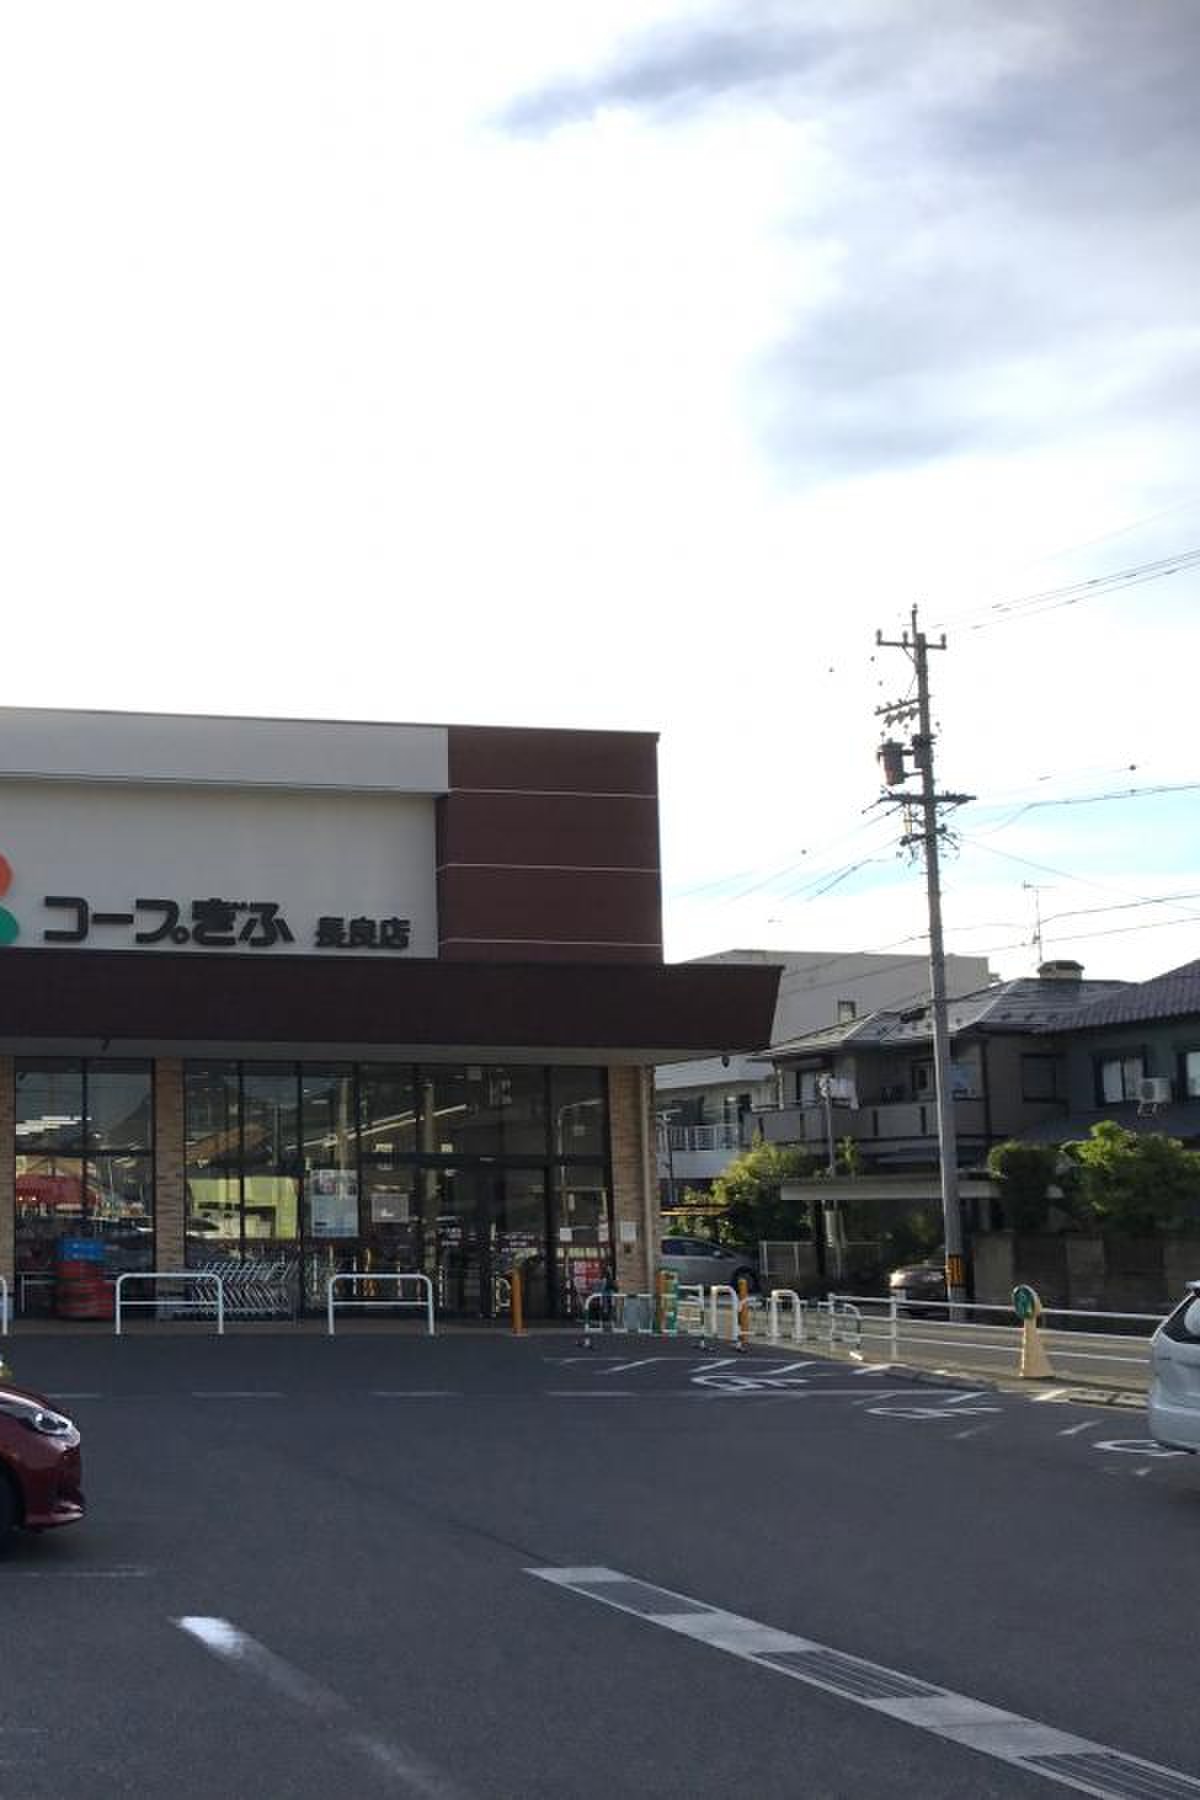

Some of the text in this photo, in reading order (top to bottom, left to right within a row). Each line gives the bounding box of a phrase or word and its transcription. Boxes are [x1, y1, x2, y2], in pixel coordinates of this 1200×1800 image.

[43, 895, 410, 950] コープぎふ 長良店
